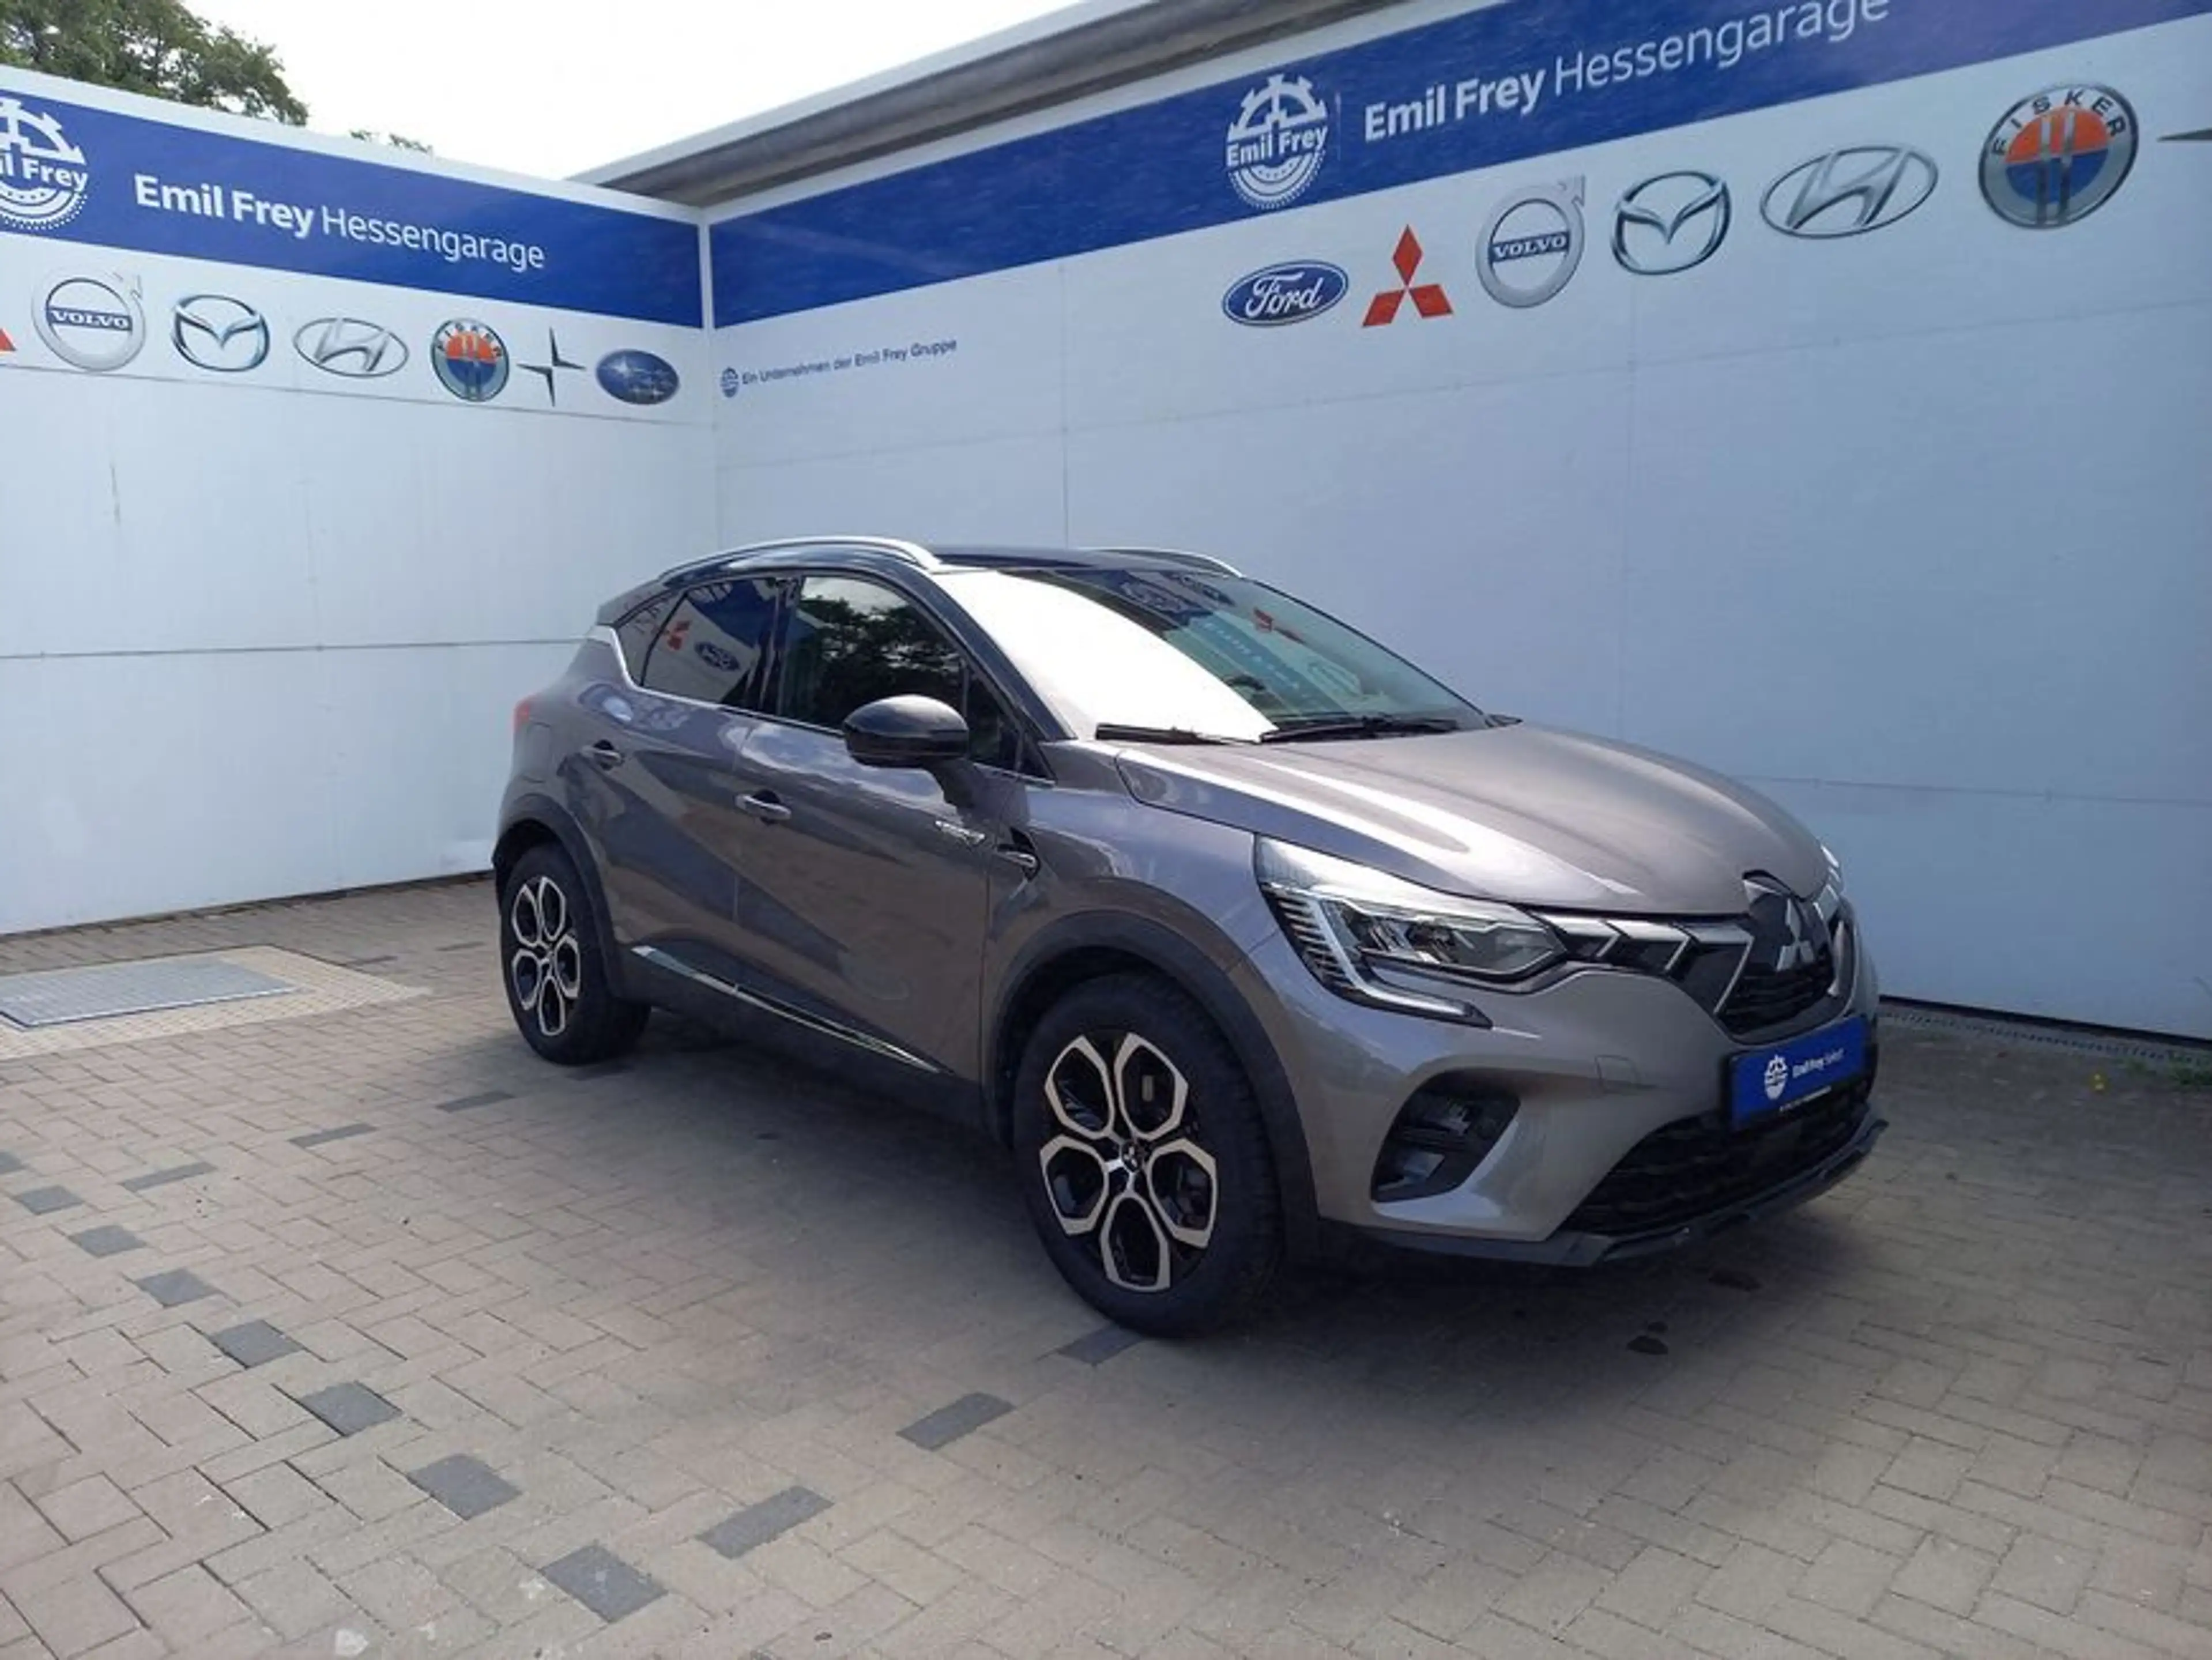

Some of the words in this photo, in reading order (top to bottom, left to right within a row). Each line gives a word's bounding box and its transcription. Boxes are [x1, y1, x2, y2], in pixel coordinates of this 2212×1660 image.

[1365, 84, 1445, 142] Emil
[1456, 69, 1546, 115] Frey
[1992, 89, 2127, 157] FISKER
[1227, 133, 1273, 168] Emil
[1279, 124, 1328, 154] Frey
[22, 157, 88, 192] Frey
[134, 173, 224, 218] Emil
[232, 190, 315, 237] Frey
[322, 205, 545, 272] Hessengarage
[1493, 233, 1567, 259] VOLVO
[1245, 272, 1321, 318] Ford
[52, 310, 130, 329] VOLVO
